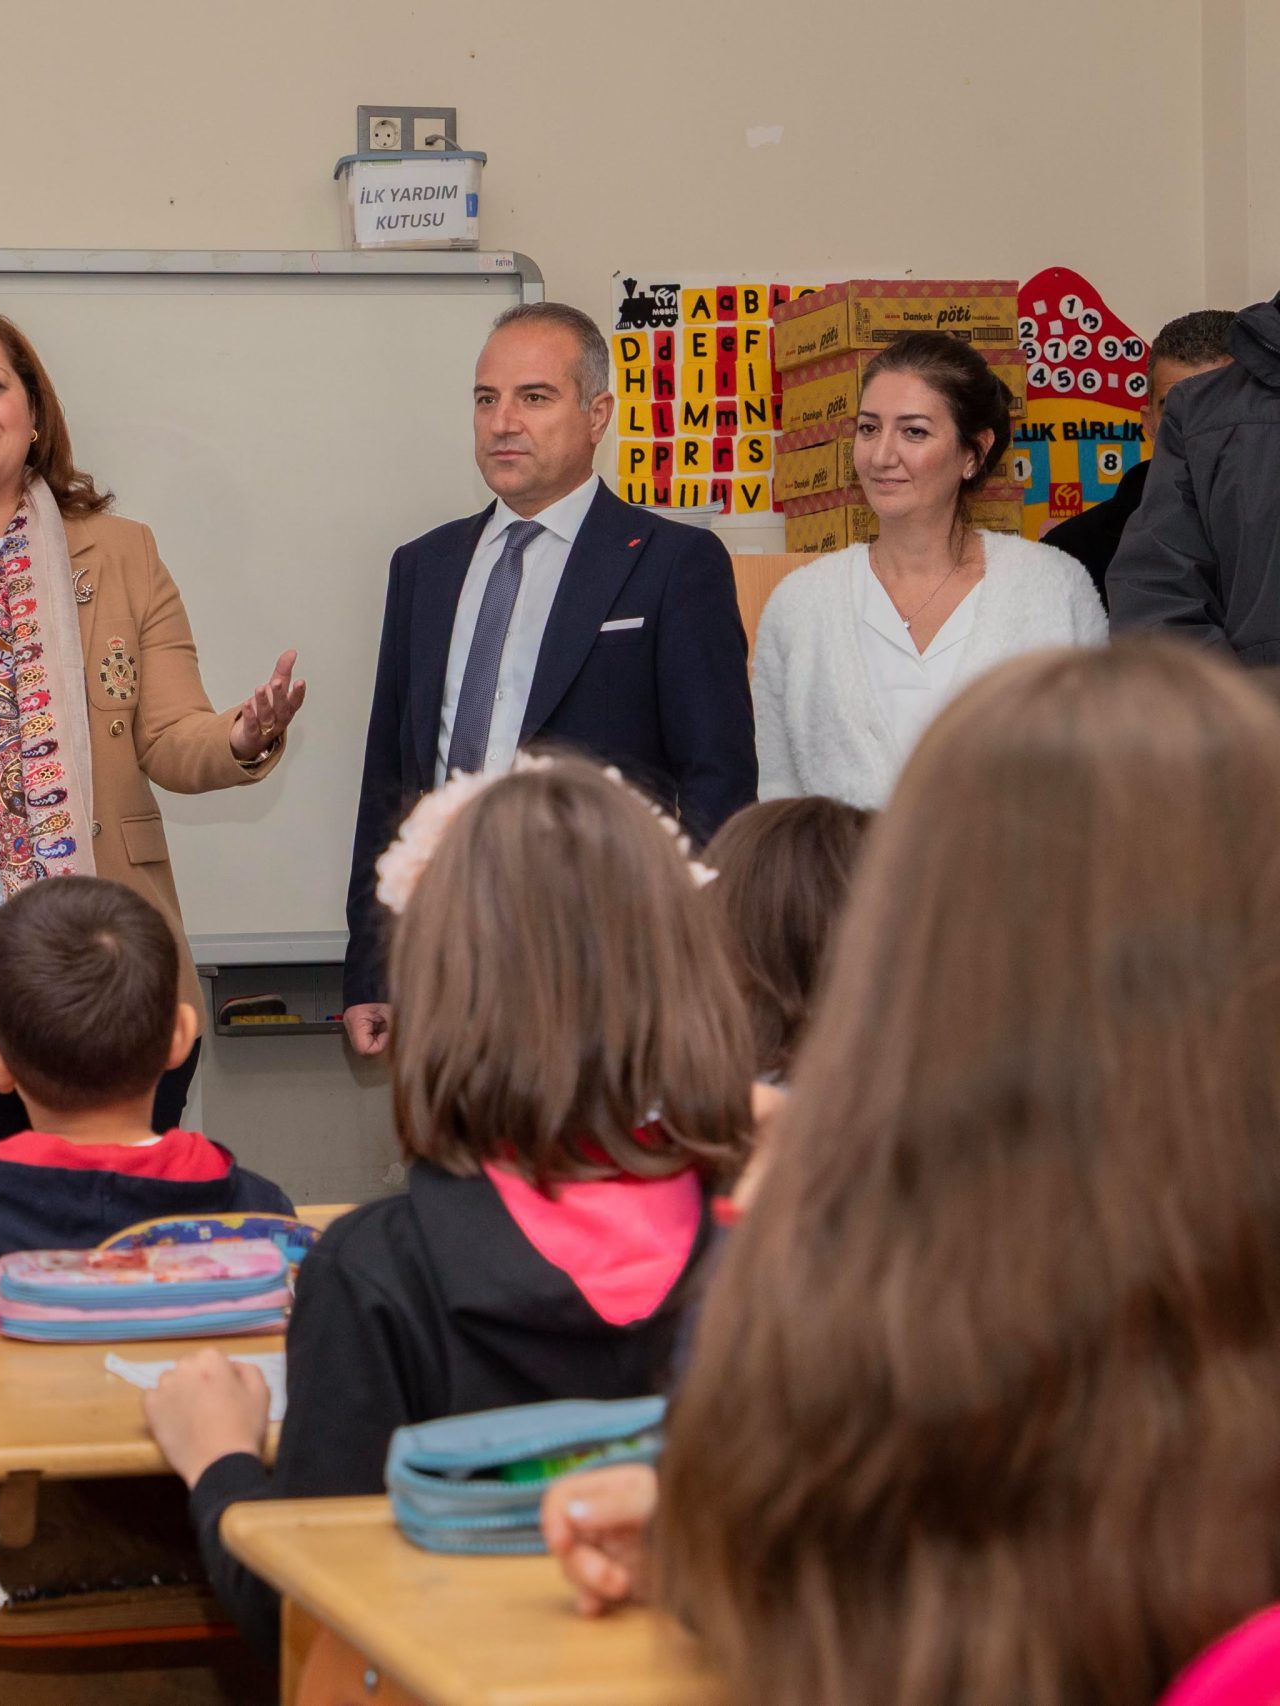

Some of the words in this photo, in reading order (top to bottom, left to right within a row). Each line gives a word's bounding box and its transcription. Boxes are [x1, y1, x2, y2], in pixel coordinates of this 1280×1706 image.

[360, 187, 386, 204] İLK
[390, 185, 458, 201] YARDIM
[376, 213, 445, 230] KUTUSU
[652, 308, 678, 316] MODEL
[691, 294, 711, 319] A
[719, 294, 734, 311] a
[744, 289, 759, 314] B
[1067, 298, 1076, 314] 1
[937, 305, 972, 329] pöti
[820, 325, 839, 352] pöti
[1020, 321, 1034, 338] 2
[620, 337, 641, 362] D
[658, 336, 672, 361] d
[693, 332, 707, 357] E
[721, 335, 735, 351] e
[745, 330, 761, 354] F
[1048, 342, 1060, 359] 7
[1073, 339, 1087, 356] 2
[1104, 341, 1118, 358] 9
[1122, 340, 1143, 357] 10
[625, 368, 645, 393] H
[658, 369, 673, 396] h
[1032, 368, 1046, 384] 4
[1057, 370, 1071, 388] 5
[1082, 372, 1096, 389] 6
[1129, 376, 1145, 393] 8
[629, 406, 645, 432] L
[684, 401, 709, 428] M
[716, 409, 738, 426] m
[744, 398, 766, 424] N
[826, 394, 848, 420] pöti
[1062, 418, 1146, 442] BİRLİK
[684, 441, 699, 466] R
[717, 447, 731, 465] r
[748, 439, 764, 463] S
[1015, 461, 1023, 477] 1
[1104, 453, 1118, 471] 8
[628, 482, 646, 504] U
[740, 483, 761, 508] V
